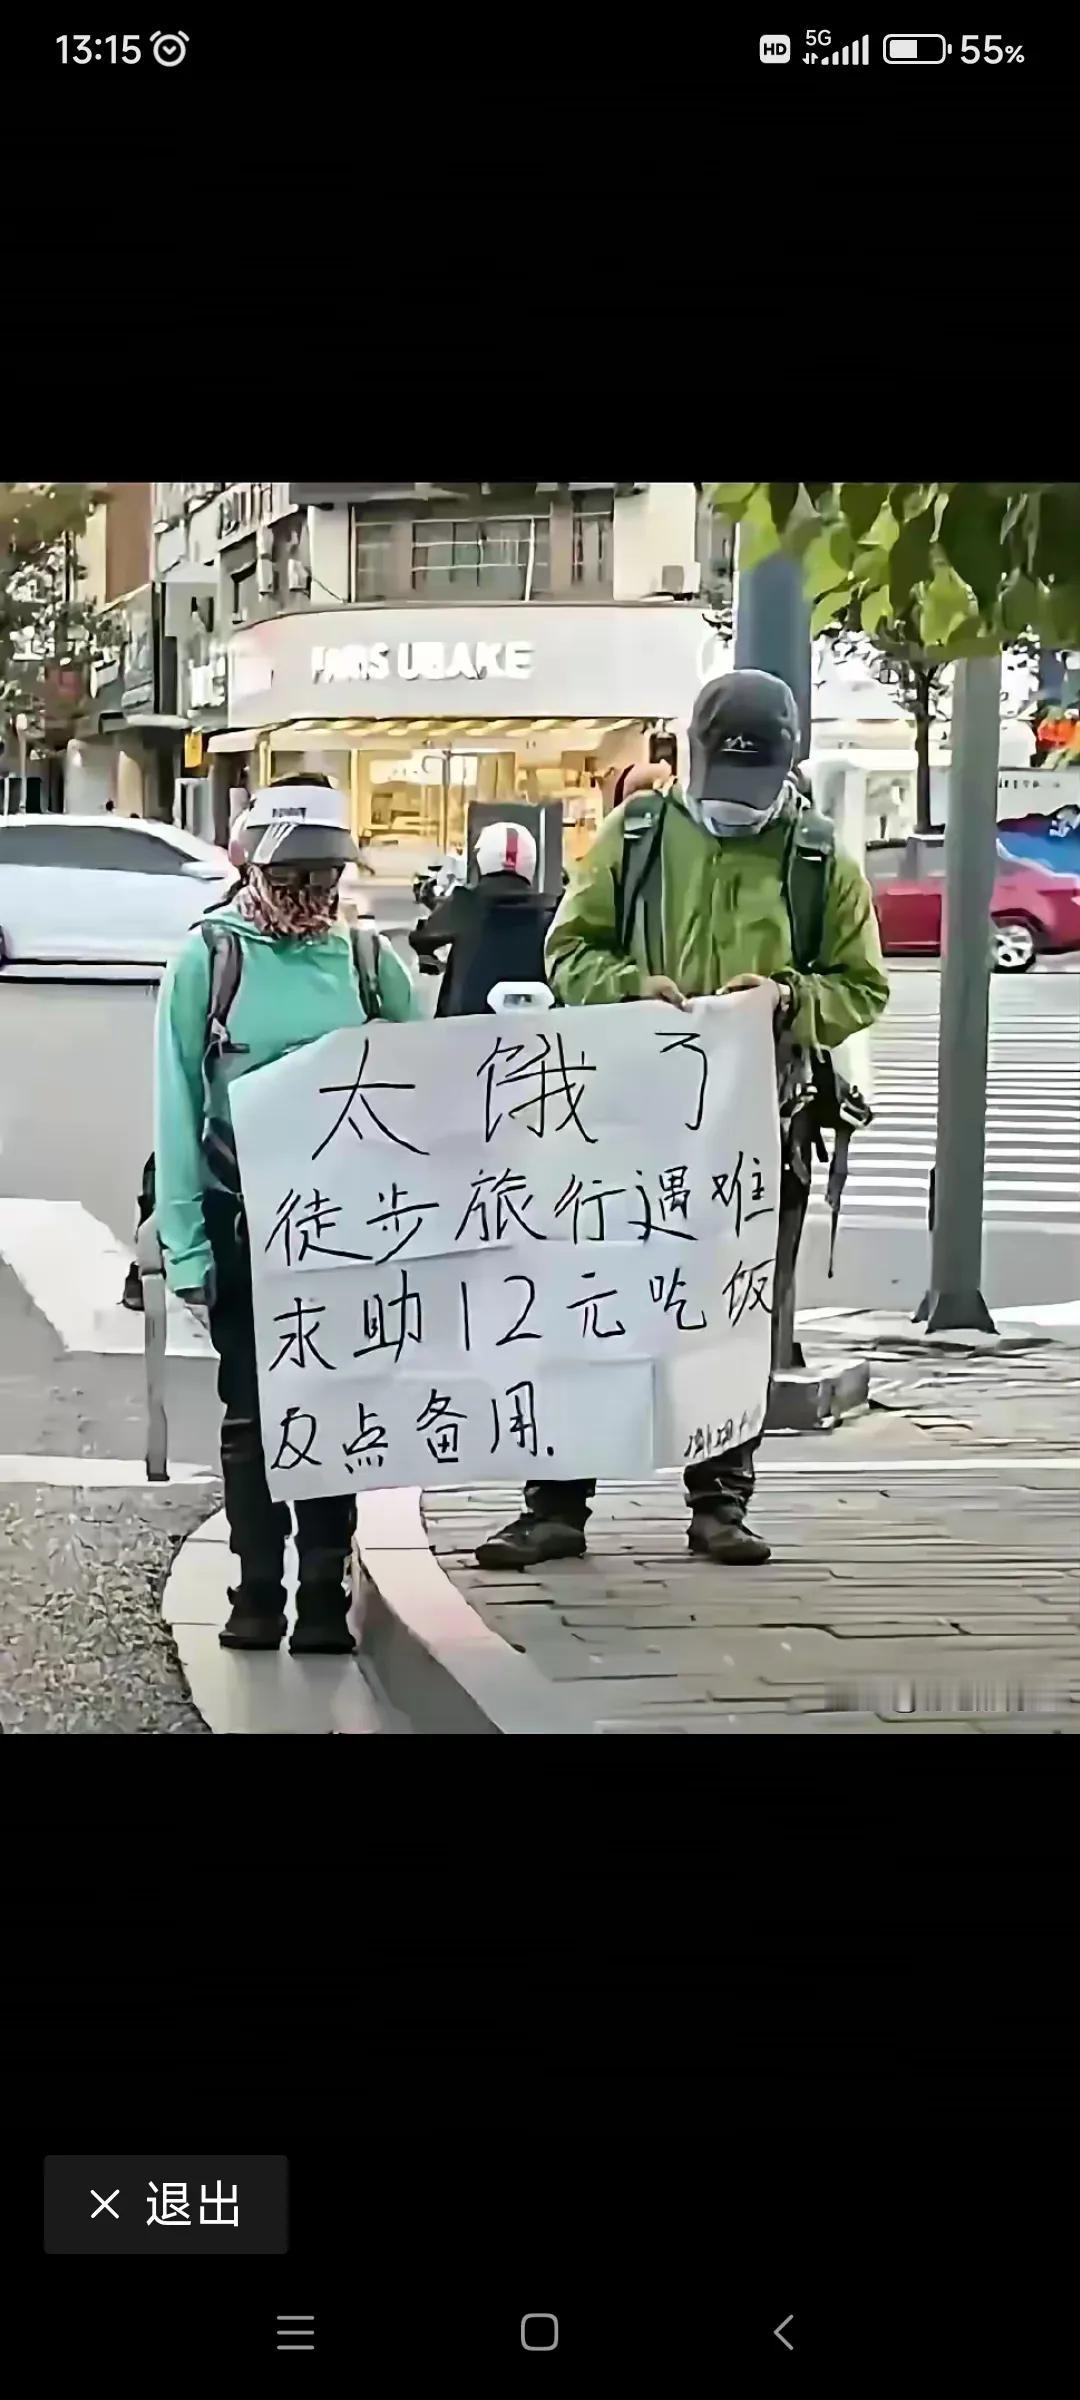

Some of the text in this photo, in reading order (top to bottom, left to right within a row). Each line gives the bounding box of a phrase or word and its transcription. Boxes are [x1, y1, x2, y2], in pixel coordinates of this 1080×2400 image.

[311, 1032, 711, 1161] 太饿了
[264, 1150, 775, 1266] 徒步旅行遇难
[268, 1257, 777, 1371] 求助12元吃饭
